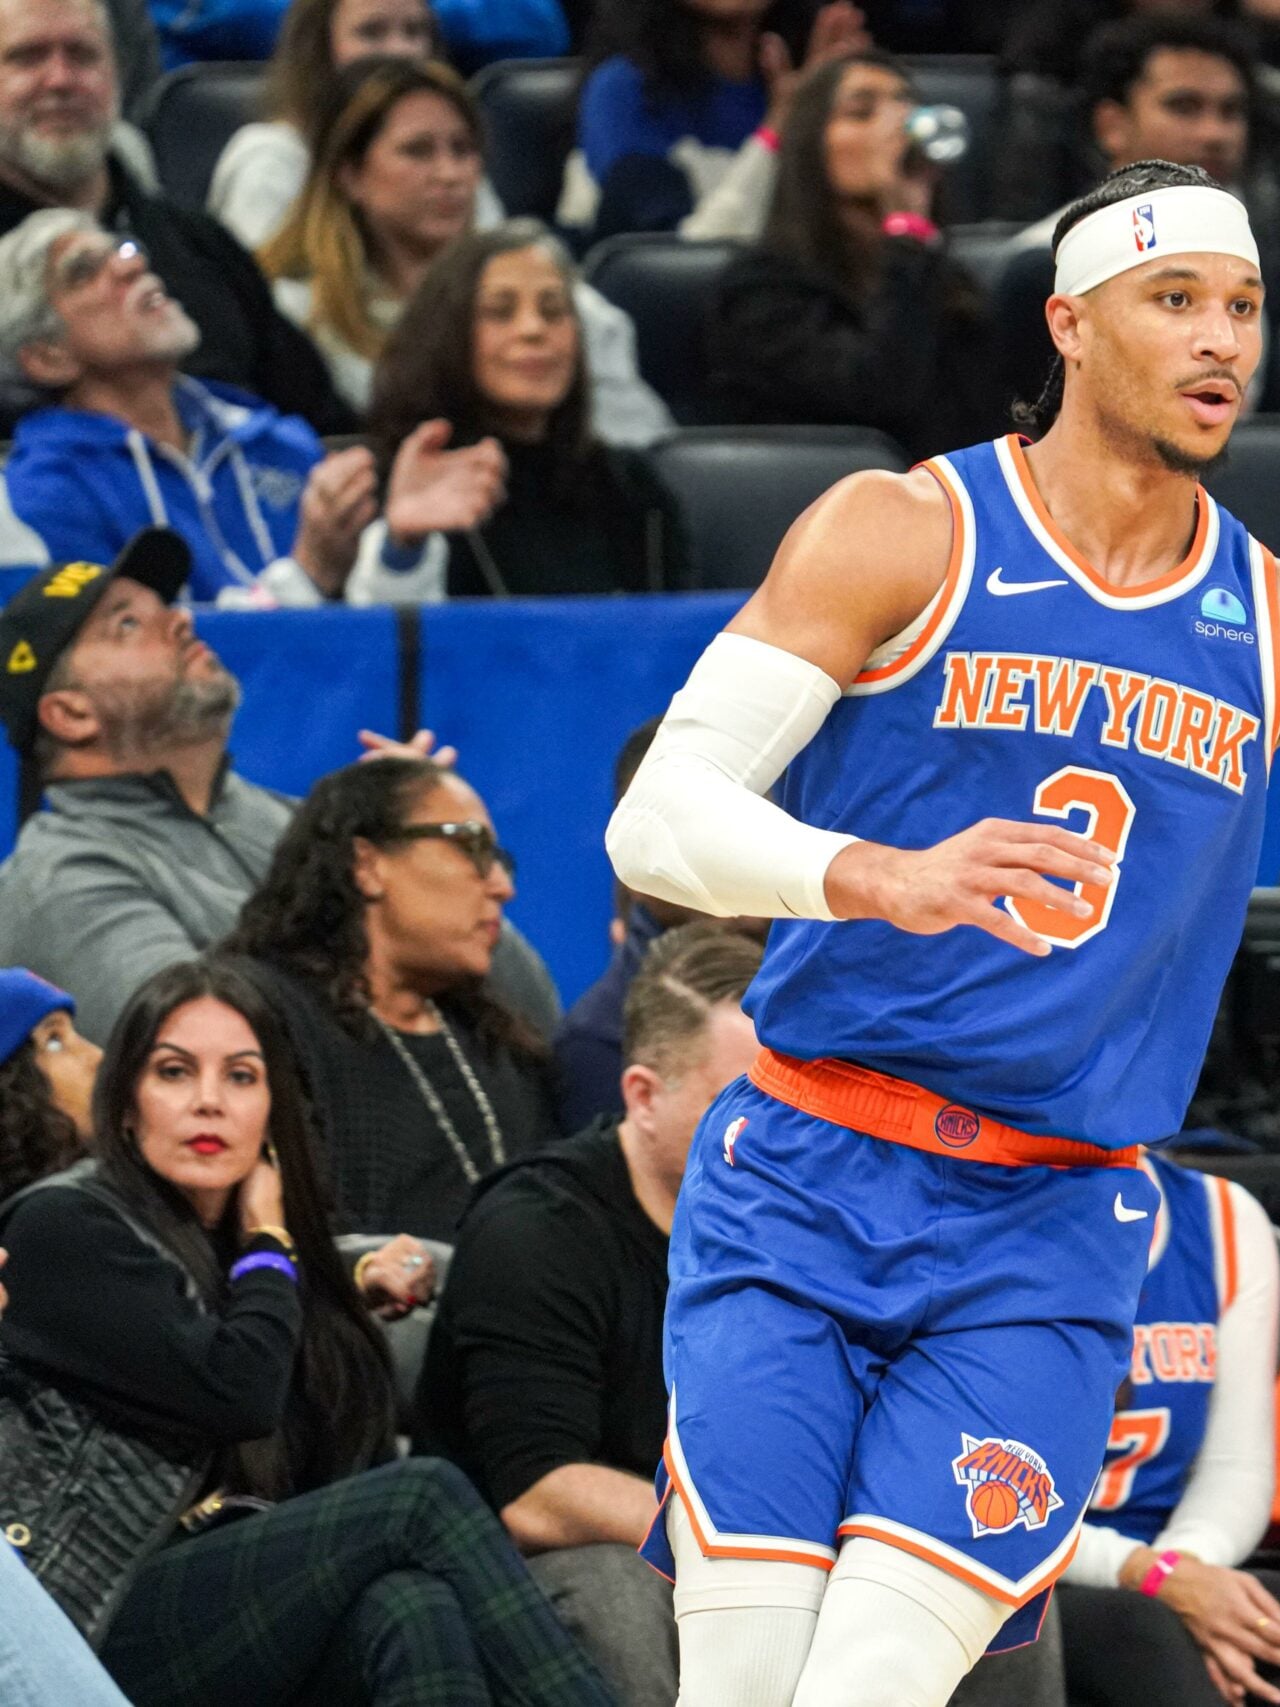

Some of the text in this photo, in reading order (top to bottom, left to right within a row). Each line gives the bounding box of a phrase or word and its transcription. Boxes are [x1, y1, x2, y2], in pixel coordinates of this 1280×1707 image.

[1194, 620, 1254, 644] sphere
[933, 651, 1260, 796] NEW YORK
[1004, 765, 1136, 949] 3
[956, 1441, 1052, 1523] KNICKS
[1090, 1407, 1171, 1511] 7
